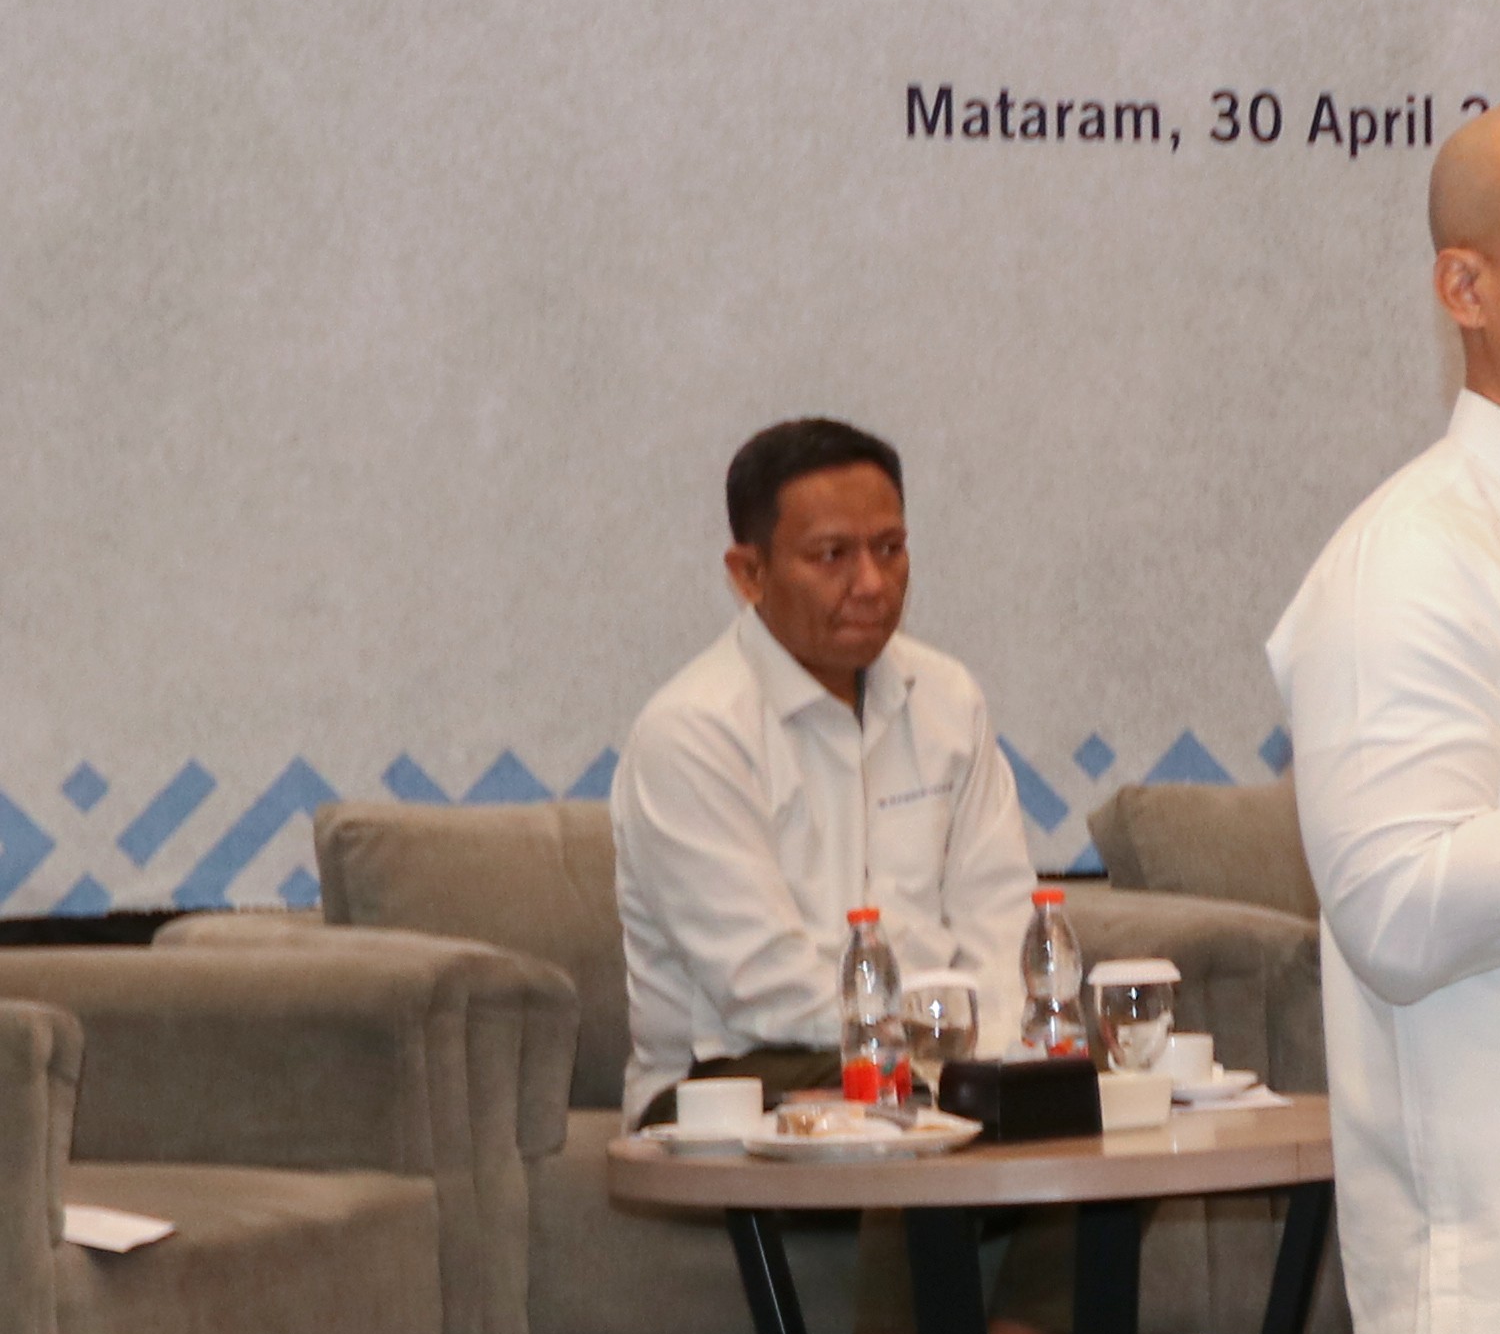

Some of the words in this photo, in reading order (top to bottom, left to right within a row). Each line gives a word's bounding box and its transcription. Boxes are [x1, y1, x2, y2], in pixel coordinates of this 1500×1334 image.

[903, 83, 1182, 152] Mataram,
[1208, 90, 1283, 143] 30
[1307, 92, 1434, 157] April
